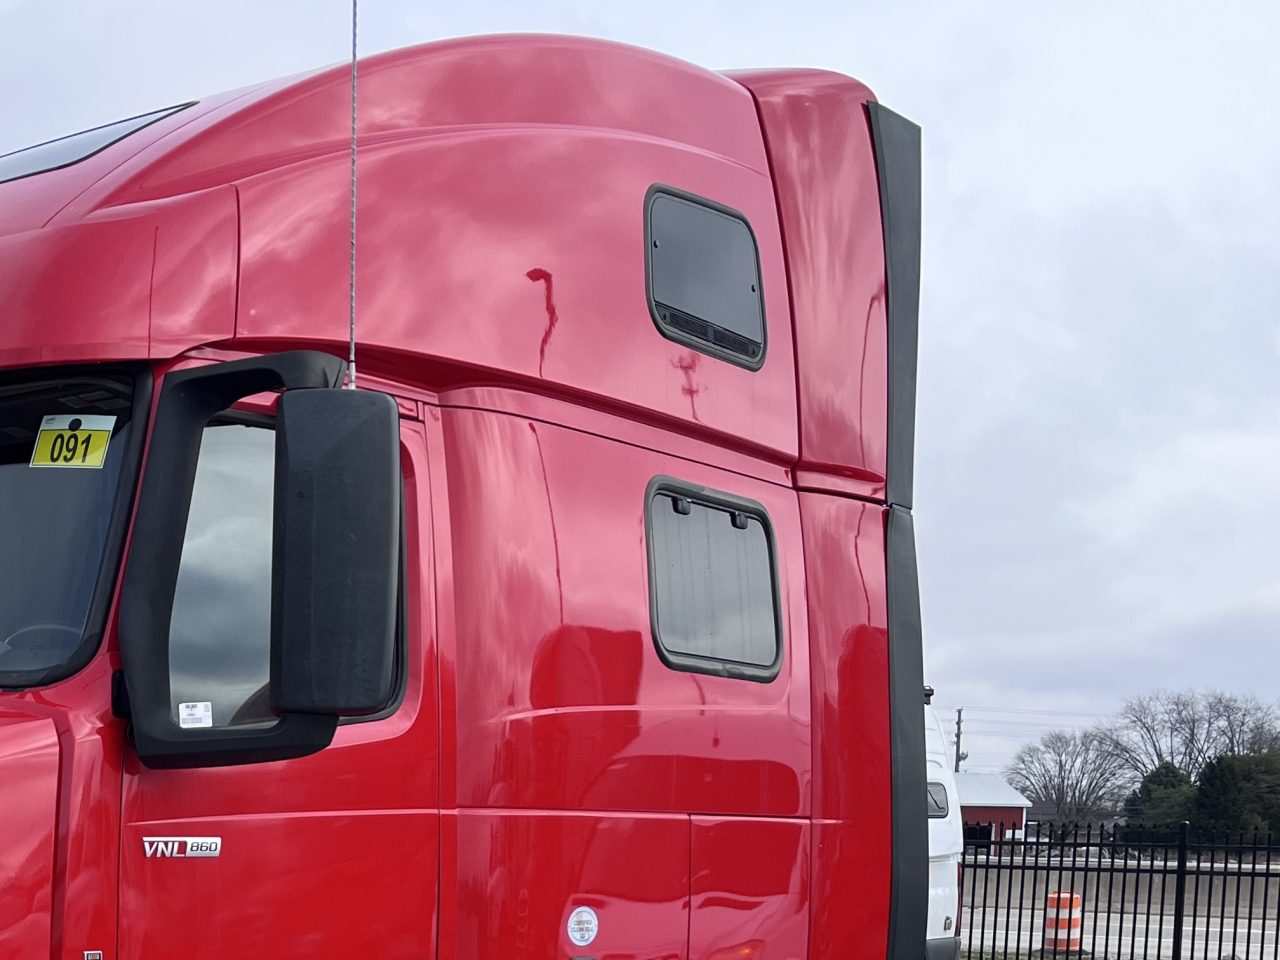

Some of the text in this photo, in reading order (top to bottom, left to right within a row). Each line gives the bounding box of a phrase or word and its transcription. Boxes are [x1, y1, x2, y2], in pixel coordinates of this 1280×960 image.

[50, 433, 93, 463] 091
[144, 841, 218, 858] VNL 860
